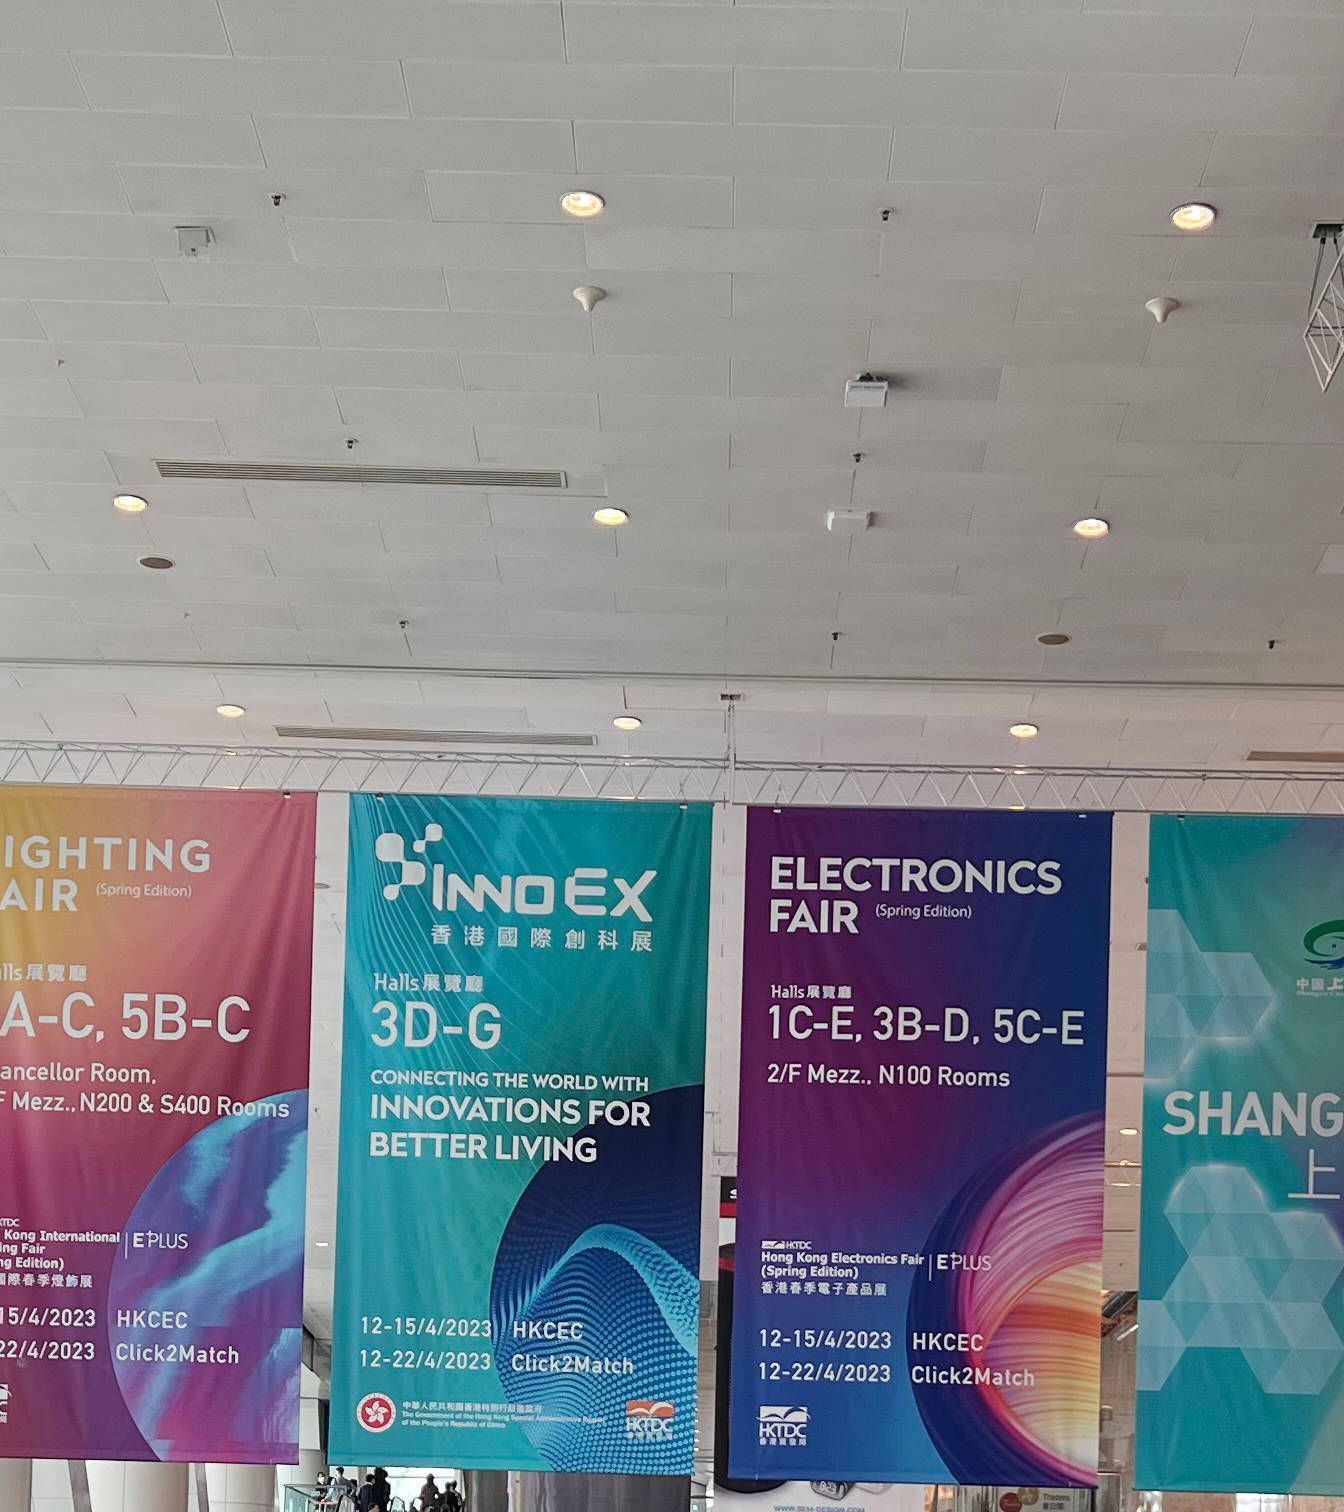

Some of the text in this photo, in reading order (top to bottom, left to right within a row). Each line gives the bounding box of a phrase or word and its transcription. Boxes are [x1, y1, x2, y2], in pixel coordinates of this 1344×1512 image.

[771, 856, 1062, 895] ELECTRONICS
[95, 882, 141, 898] (Spring
[144, 883, 193, 898] Edition)
[769, 899, 972, 934] FAIR (Spring Edition)
[431, 924, 654, 951] 香港國際創科展
[373, 973, 420, 992] Halls
[771, 984, 805, 999] Halls
[121, 993, 251, 1043] 5B-C
[370, 1000, 502, 1049] 3D-G
[769, 1005, 1085, 1046] 1C-E, 3B-D, 5C-E
[90, 1063, 157, 1085] Room,
[370, 1069, 649, 1092] CONNECTING THE WORLD WITH
[767, 1064, 801, 1084] 2/F
[879, 1065, 931, 1085] N100
[938, 1066, 1010, 1087] Rooms
[80, 1092, 133, 1113] N200
[138, 1095, 155, 1114] &
[159, 1095, 211, 1115] S400
[217, 1096, 290, 1119] Rooms
[370, 1094, 651, 1128] INNOVATIONS FOR
[369, 1132, 597, 1163] BETTER LIVING
[4, 1229, 36, 1242] Kong
[40, 1230, 121, 1242] International
[21, 1242, 46, 1254] Fair
[761, 1251, 925, 1265] Hong Kong Electronics Fair
[15, 1256, 64, 1271] Edition)
[761, 1264, 859, 1280] (Spring Edition)
[116, 1310, 189, 1329] HKCEC
[359, 1316, 583, 1339] 12-15/4/2023 HKCEC
[759, 1329, 984, 1352] 12-15/4/2023 HKCEC
[115, 1343, 239, 1365] Click2Match
[359, 1349, 635, 1376] 12-22/4/2023 Click2Match
[758, 1362, 1035, 1388] 12-22/4/2023 Click2Match
[759, 1422, 807, 1438] HKTDC
